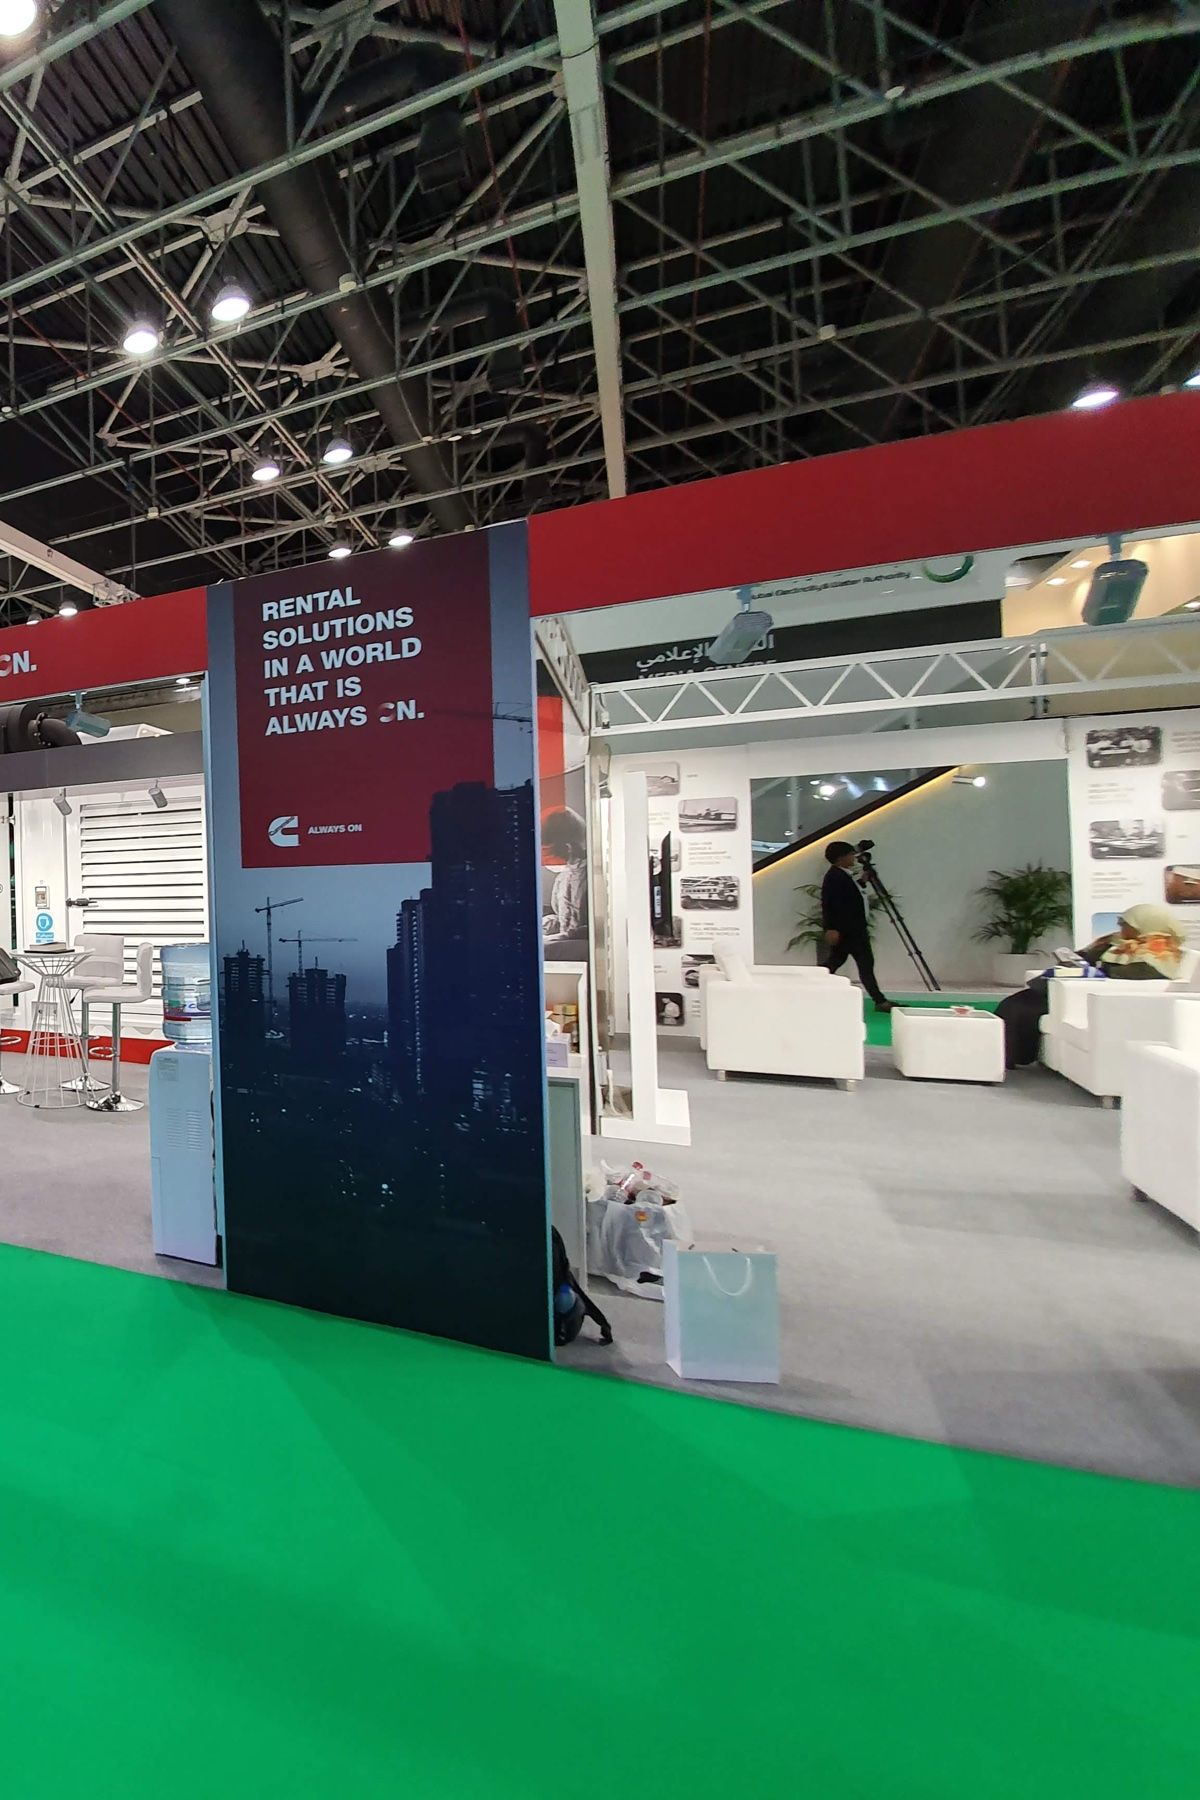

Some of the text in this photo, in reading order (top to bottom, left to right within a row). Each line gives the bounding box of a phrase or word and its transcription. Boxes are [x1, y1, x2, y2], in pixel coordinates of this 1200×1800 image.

[262, 586, 362, 622] RENTAL
[262, 606, 414, 650] SOLUTIONS
[264, 637, 422, 679] IN A WORLD
[264, 676, 362, 707] THAT IS
[265, 705, 368, 736] ALWAYS
[307, 824, 346, 835] ALWAYS
[347, 823, 363, 833] ON
